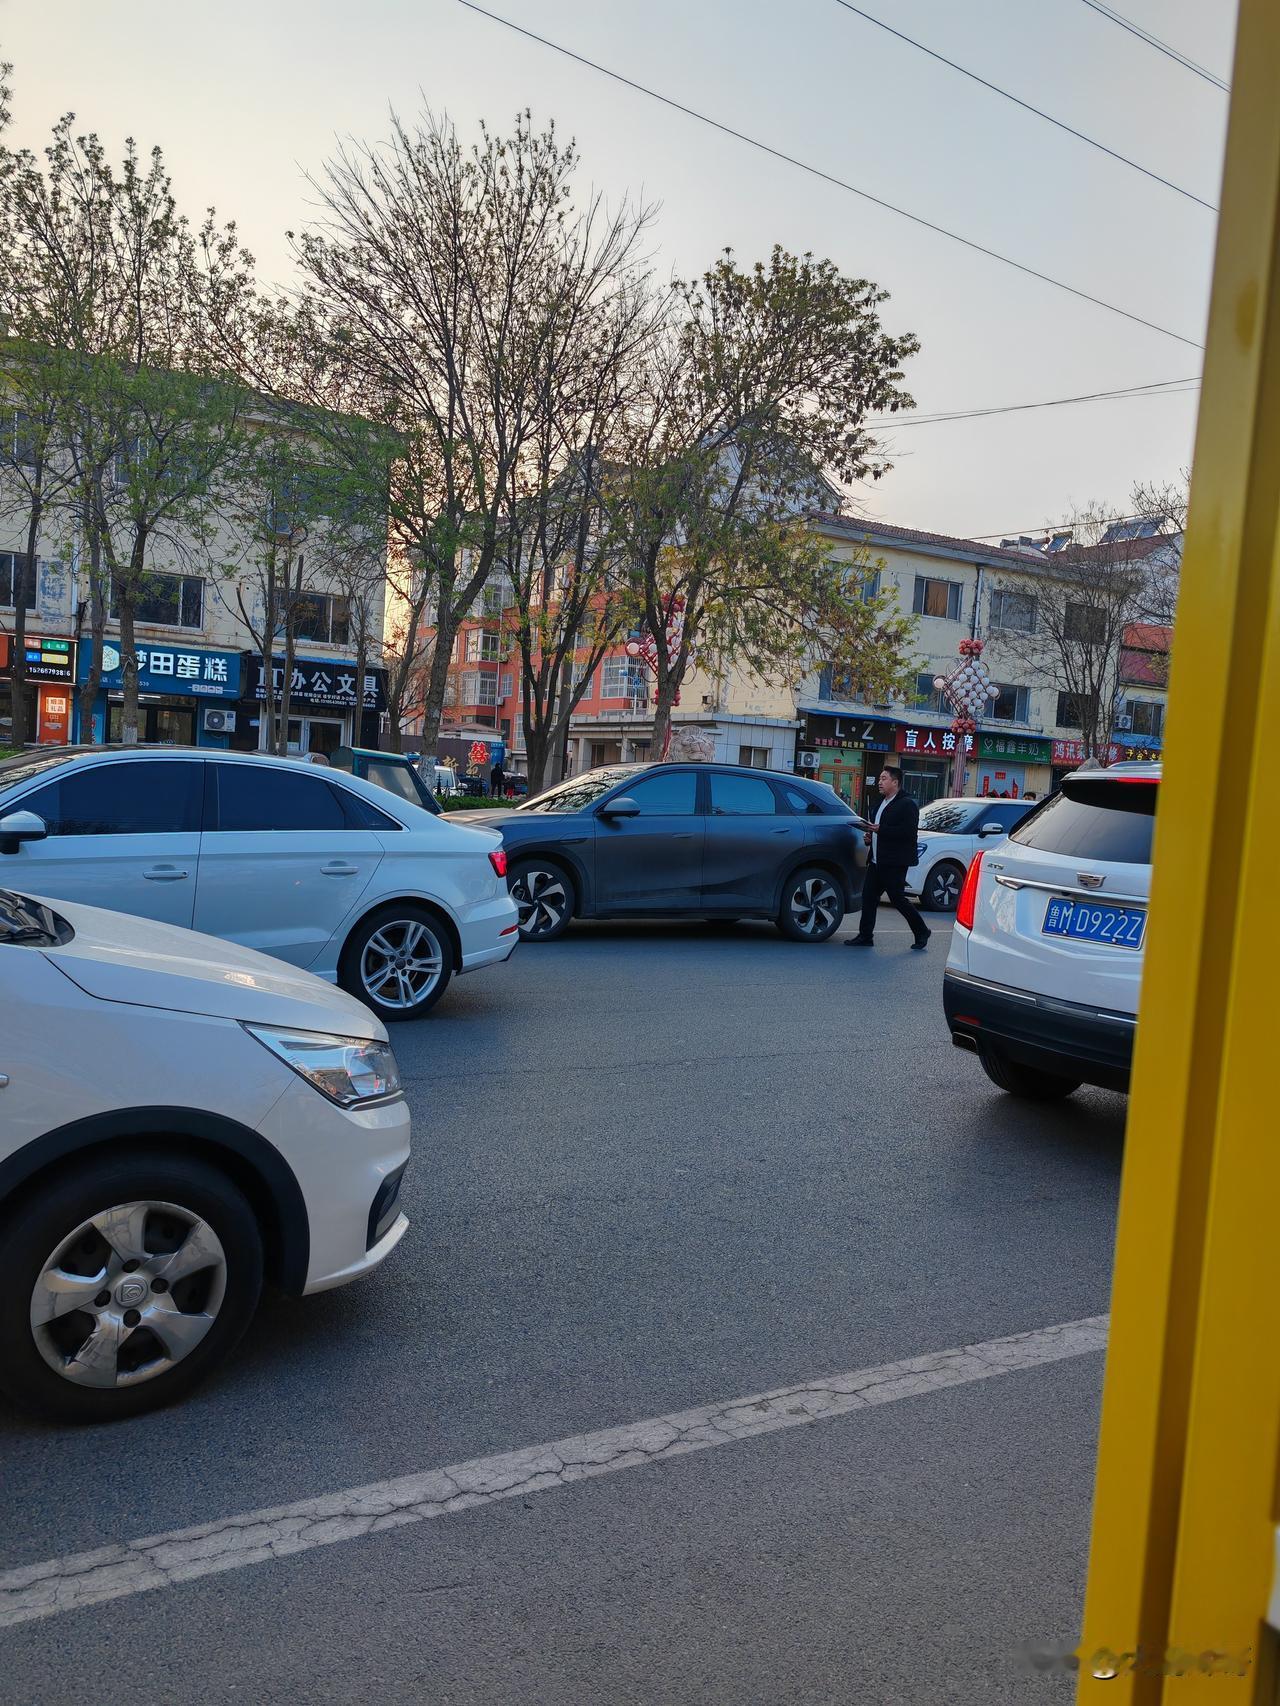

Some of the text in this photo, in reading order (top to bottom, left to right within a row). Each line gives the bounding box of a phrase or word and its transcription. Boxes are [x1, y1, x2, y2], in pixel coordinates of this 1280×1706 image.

[905, 729, 974, 752] 盲人按摩
[1054, 742, 1118, 761] 鸿讯家修
